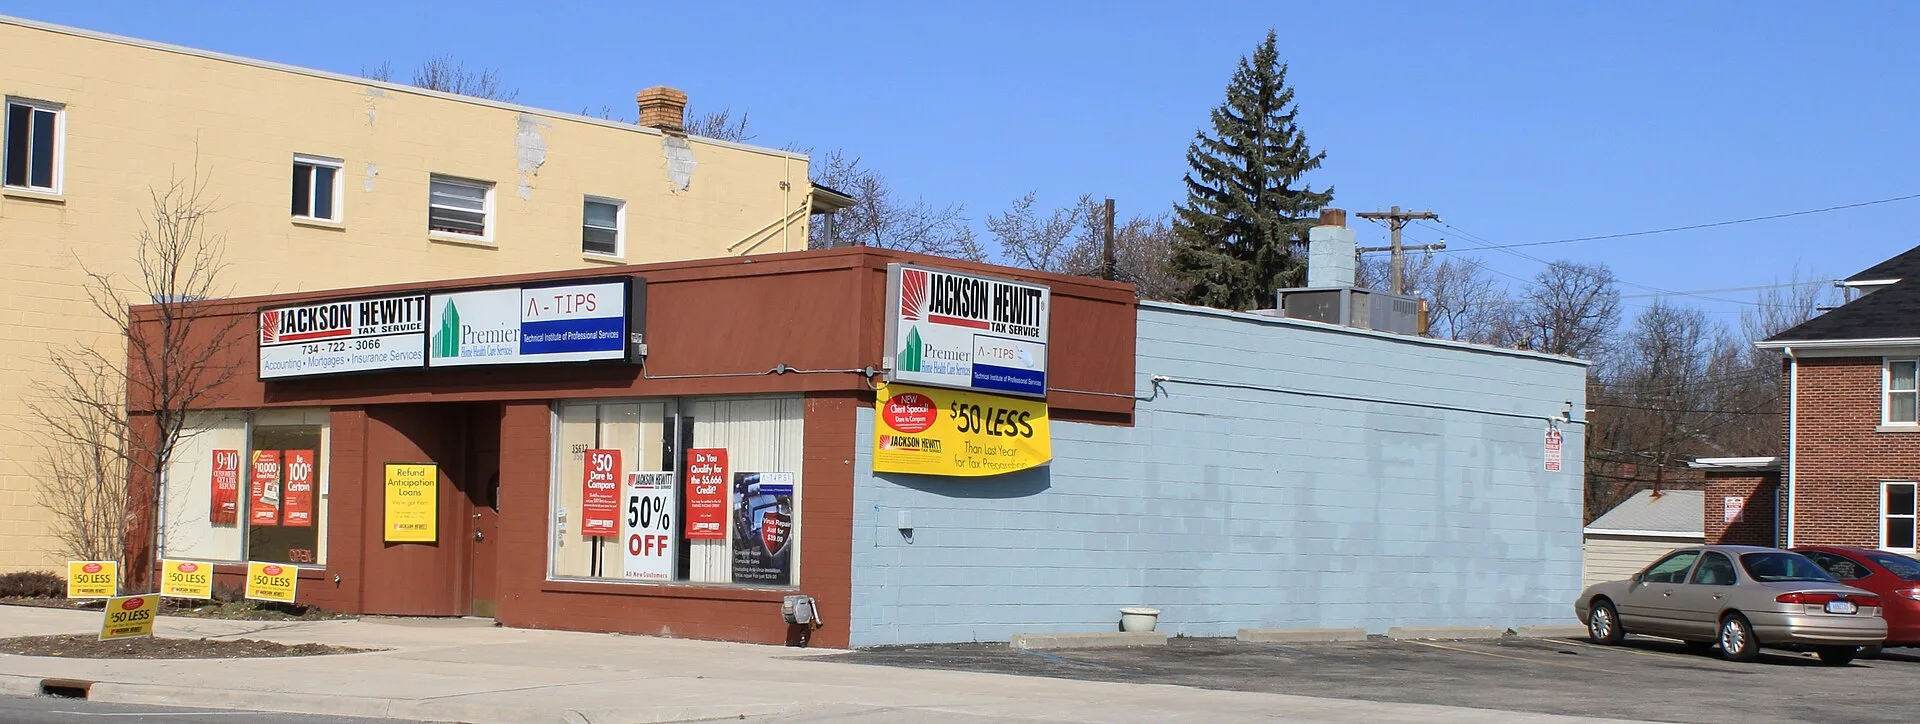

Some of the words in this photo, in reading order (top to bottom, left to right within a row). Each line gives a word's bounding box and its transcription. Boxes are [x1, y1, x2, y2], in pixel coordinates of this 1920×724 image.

[929, 274, 988, 320] JACKSON
[993, 283, 1042, 327] HEWITT
[279, 303, 352, 335] JACKSON
[360, 297, 424, 326] HEWITT
[358, 327, 376, 335] TAX
[382, 323, 422, 333] SERVICE
[462, 322, 520, 345] Premier
[991, 322, 1006, 333] TAX
[1009, 324, 1040, 338] SERVICE
[524, 334, 544, 342] Technical
[545, 333, 561, 341] Institute
[562, 332, 567, 340] of
[568, 331, 597, 340] Professional
[599, 330, 618, 339] Services
[302, 345, 318, 355] 734
[328, 342, 345, 353] 722
[356, 339, 380, 350] 3066
[461, 346, 472, 357] Home
[473, 345, 486, 357] Health
[497, 344, 513, 355] Services
[924, 344, 971, 361] Premier
[264, 358, 301, 371] Accounting
[308, 355, 344, 369] Mortgages
[352, 352, 388, 365] Insurance
[389, 350, 422, 361] Services
[974, 371, 989, 380] Technical
[1008, 375, 1028, 385] Professional
[1028, 378, 1042, 386] Services
[901, 395, 917, 403] NEW
[890, 404, 905, 414] Client
[950, 400, 981, 434] $50
[986, 407, 1033, 438] LESS
[890, 436, 919, 448] JACKSON
[922, 438, 941, 449] HEWITT
[965, 440, 982, 453] Than
[984, 443, 996, 455] Last
[997, 445, 1017, 456] Year
[296, 454, 303, 463] Be
[592, 453, 612, 471] $50
[696, 454, 705, 462] Do
[706, 453, 717, 462] You
[955, 454, 965, 467] for
[968, 457, 981, 468] Tax
[255, 462, 276, 473] $10,000
[289, 463, 312, 481] 100%
[397, 467, 425, 476] Refund
[691, 464, 712, 475] Qualify
[713, 464, 722, 473] for
[590, 471, 605, 480] Dare
[606, 471, 613, 480] to
[636, 474, 654, 485] JACKSON
[655, 474, 673, 485] HEWITT
[691, 475, 700, 484] the
[288, 481, 310, 491] Certain
[388, 478, 434, 488] Anticipation
[587, 480, 615, 491] Compare
[398, 488, 422, 496] Loans
[696, 486, 716, 494] Credit?
[628, 496, 669, 530] 50%
[775, 519, 791, 528] Repair
[629, 534, 668, 556] OFF
[74, 574, 88, 583] $50
[91, 574, 110, 583] LESS
[169, 572, 183, 582] $50
[185, 573, 206, 583] LESS
[254, 575, 268, 585] $50
[270, 576, 290, 587] LESS
[110, 611, 126, 622] $50
[128, 609, 150, 620] LESS
